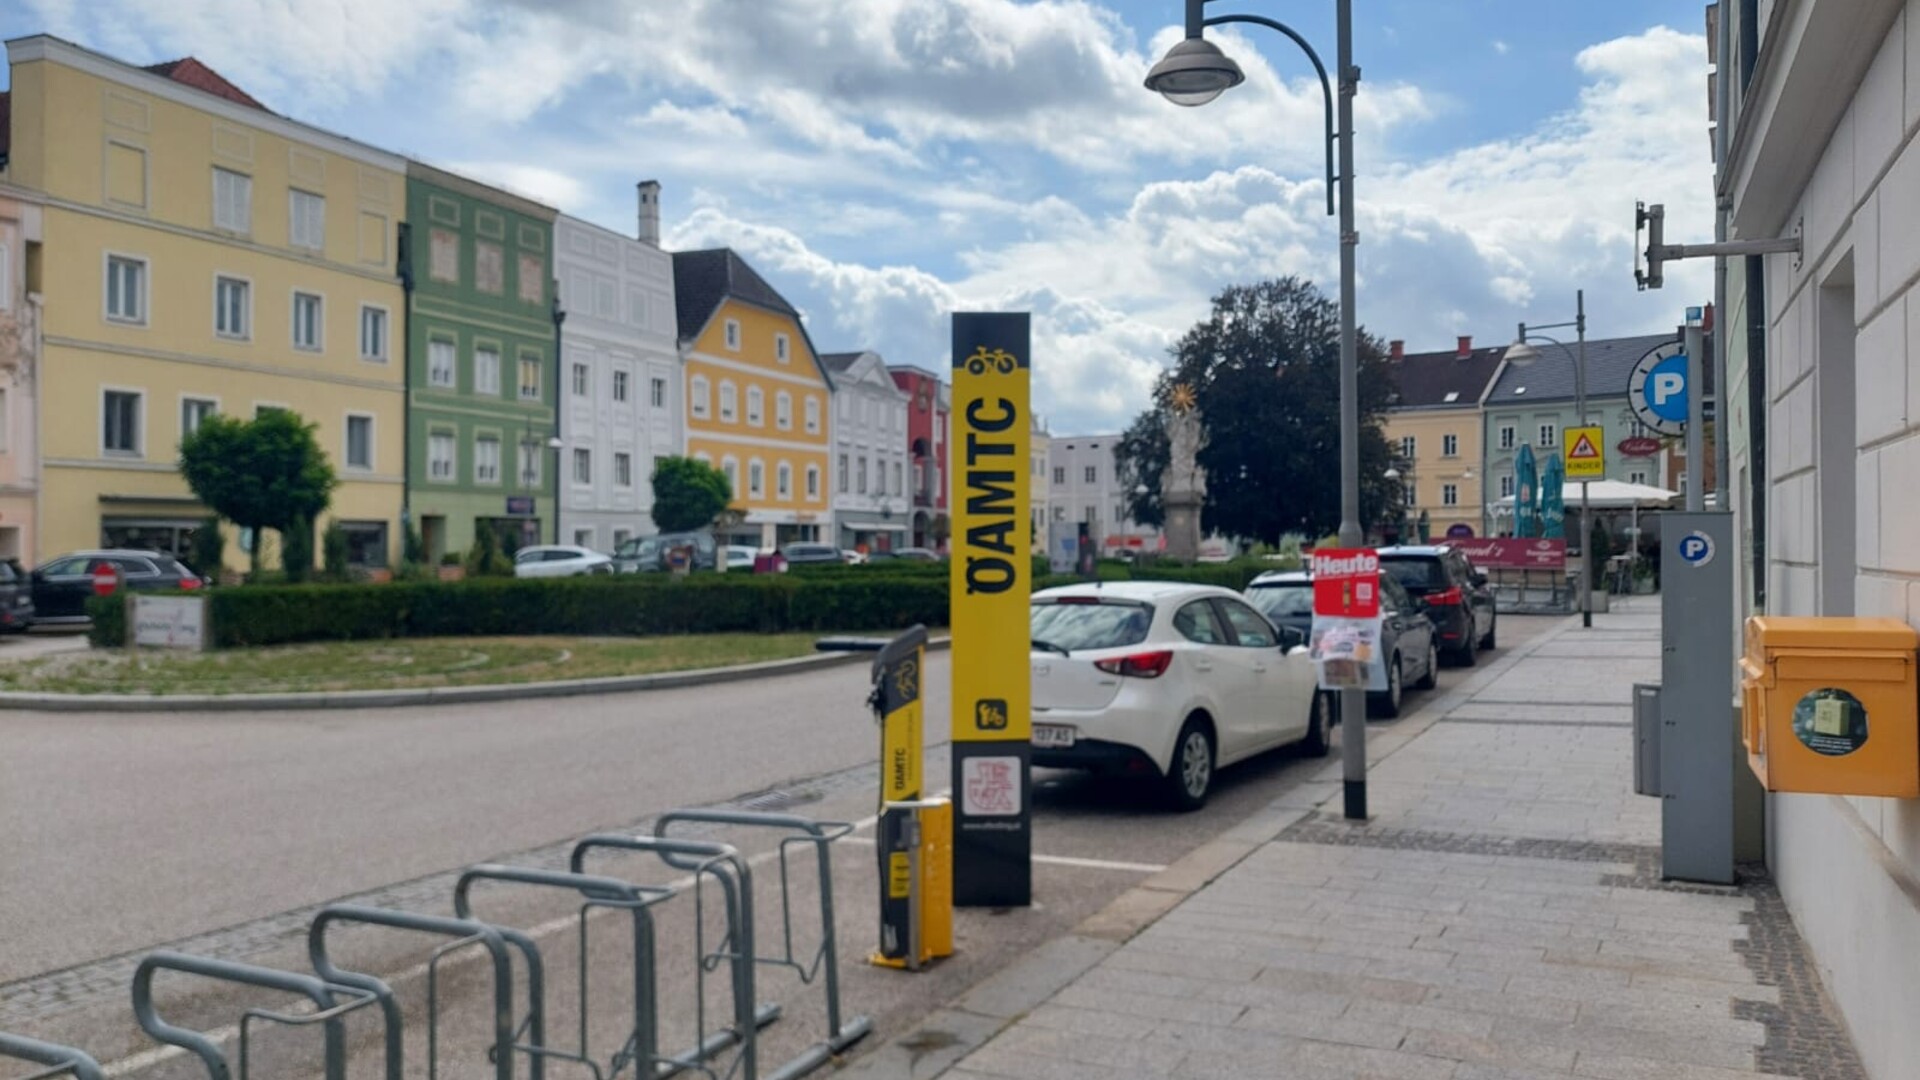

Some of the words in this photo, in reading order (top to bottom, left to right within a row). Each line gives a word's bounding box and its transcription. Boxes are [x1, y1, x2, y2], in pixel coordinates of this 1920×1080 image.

[1654, 372, 1685, 405] P
[1567, 460, 1601, 470] KINDER
[966, 397, 1016, 595] ÖAMTC
[1687, 539, 1705, 558] P
[1315, 553, 1377, 576] Heute
